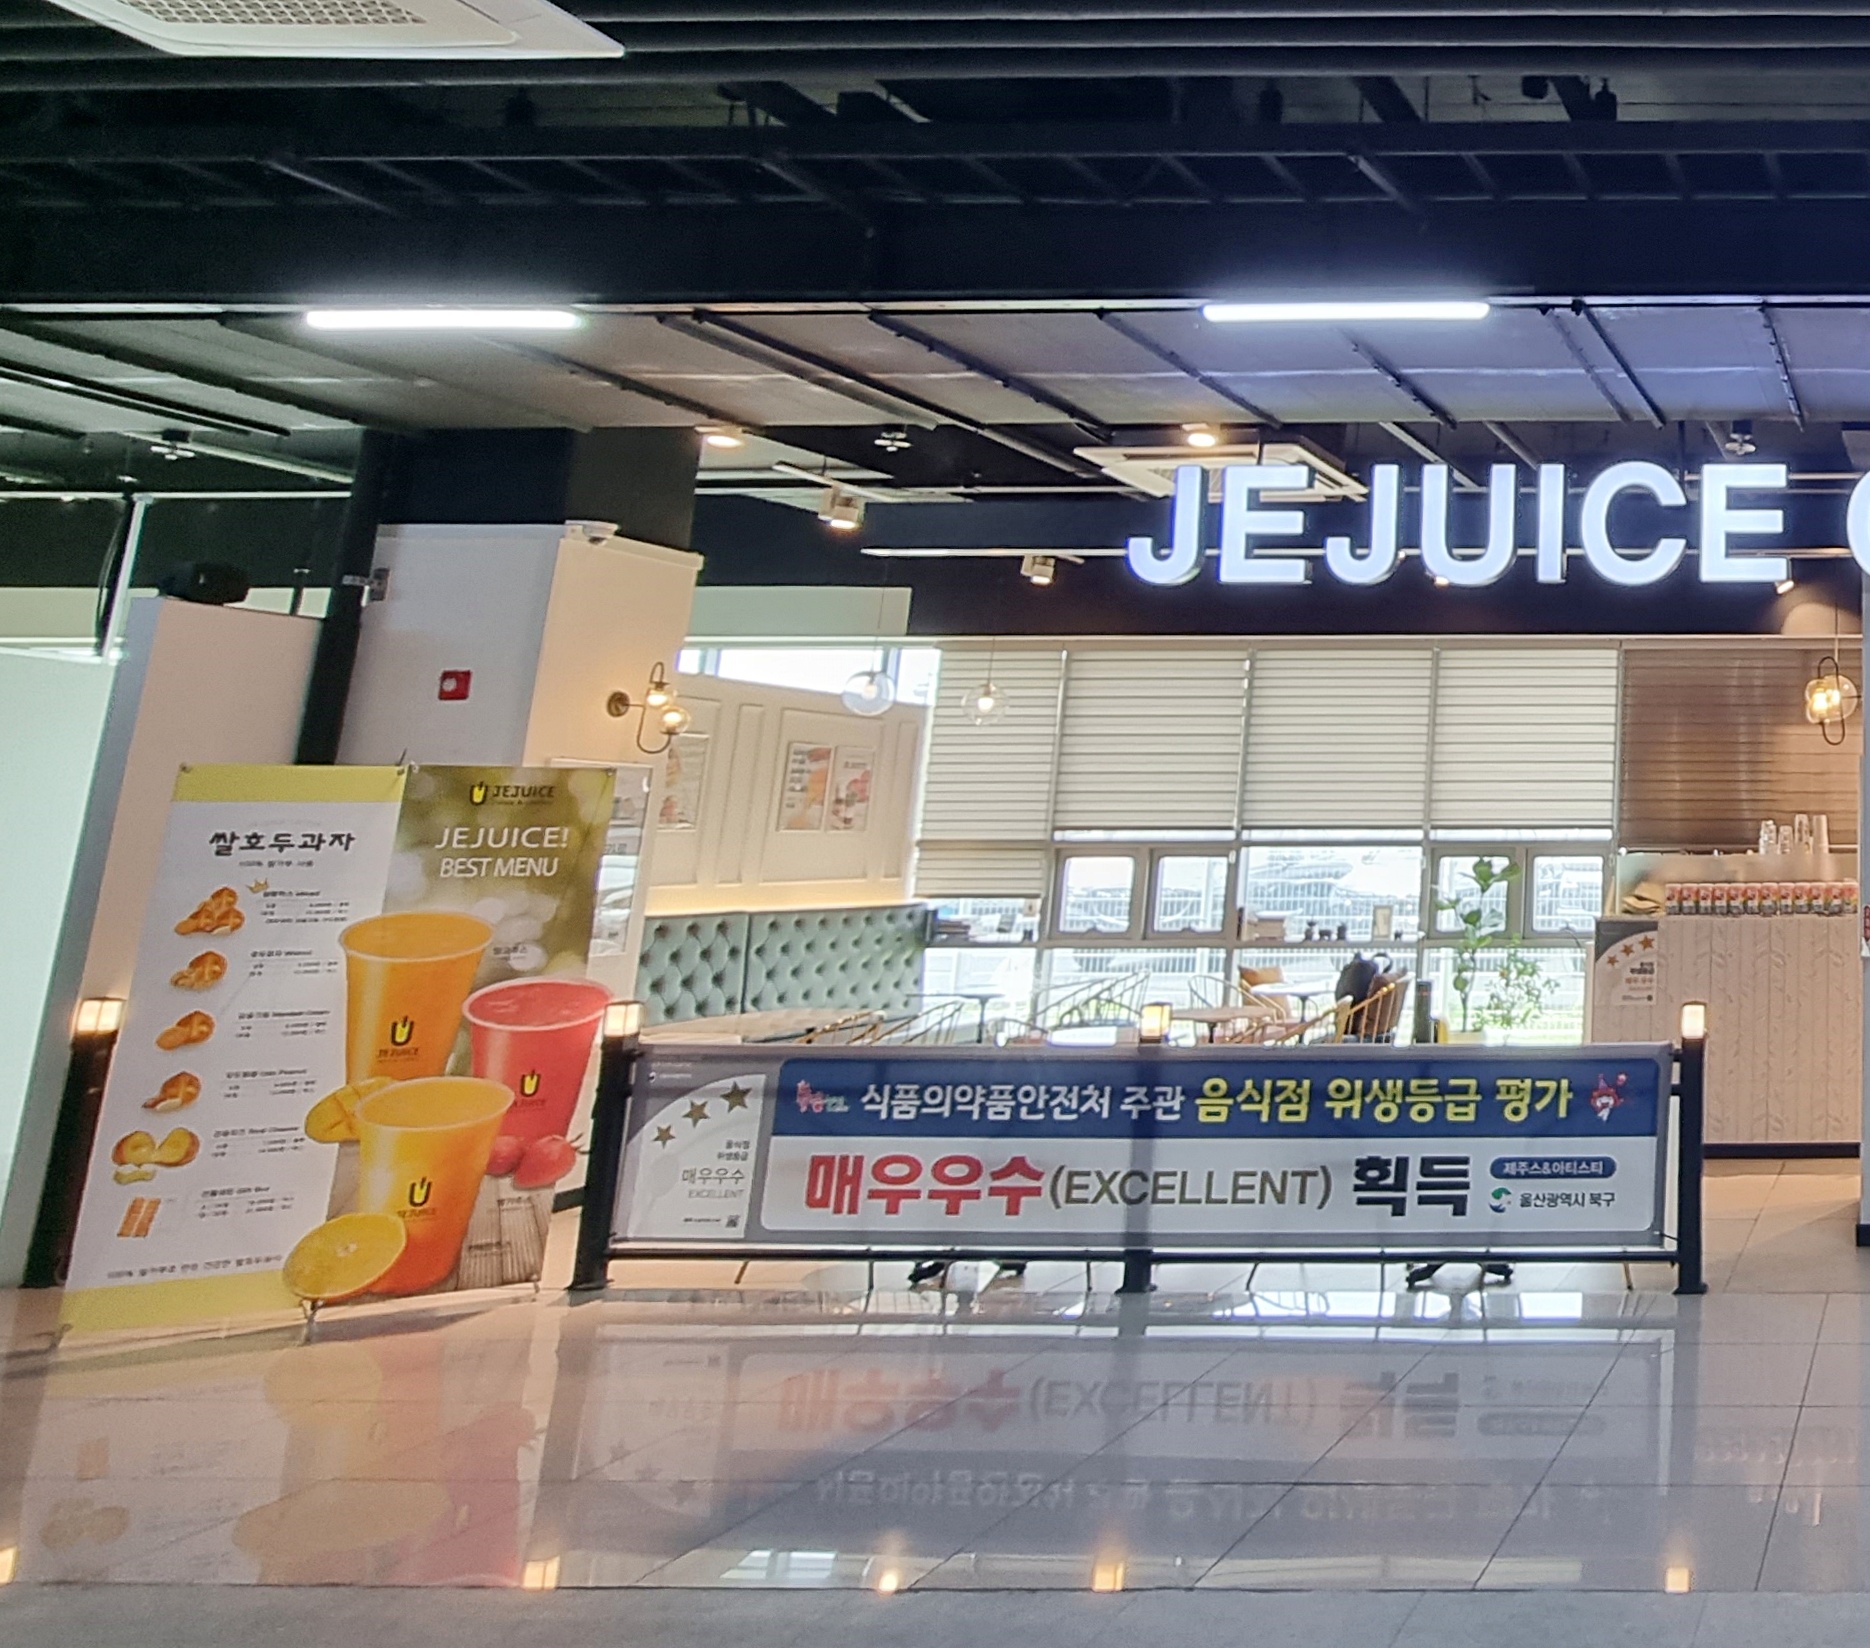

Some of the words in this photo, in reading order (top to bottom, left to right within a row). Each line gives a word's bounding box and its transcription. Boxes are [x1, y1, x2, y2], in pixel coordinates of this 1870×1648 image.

[1126, 461, 1790, 586] JEJUICE
[492, 785, 555, 798] JEJUICE
[208, 831, 355, 856] 쌀호두과자
[435, 827, 570, 849] JEJUICE!
[440, 857, 492, 877] BEST
[494, 857, 559, 877] MENU
[861, 1083, 1111, 1121] 식품의약품안전처
[1120, 1083, 1184, 1121] 주관
[1195, 1077, 1311, 1123] 음식점
[1324, 1077, 1482, 1122] 위생등급
[1494, 1077, 1574, 1123] 평가
[681, 1166, 745, 1186] 매우우수
[806, 1153, 1045, 1217] 매우우수
[1049, 1163, 1333, 1212] (EXCELLENT)
[1352, 1155, 1470, 1217] 획득
[688, 1188, 745, 1200] EXCELLENT
[1519, 1191, 1586, 1208] 울산광역시
[1589, 1191, 1616, 1208] 북구
